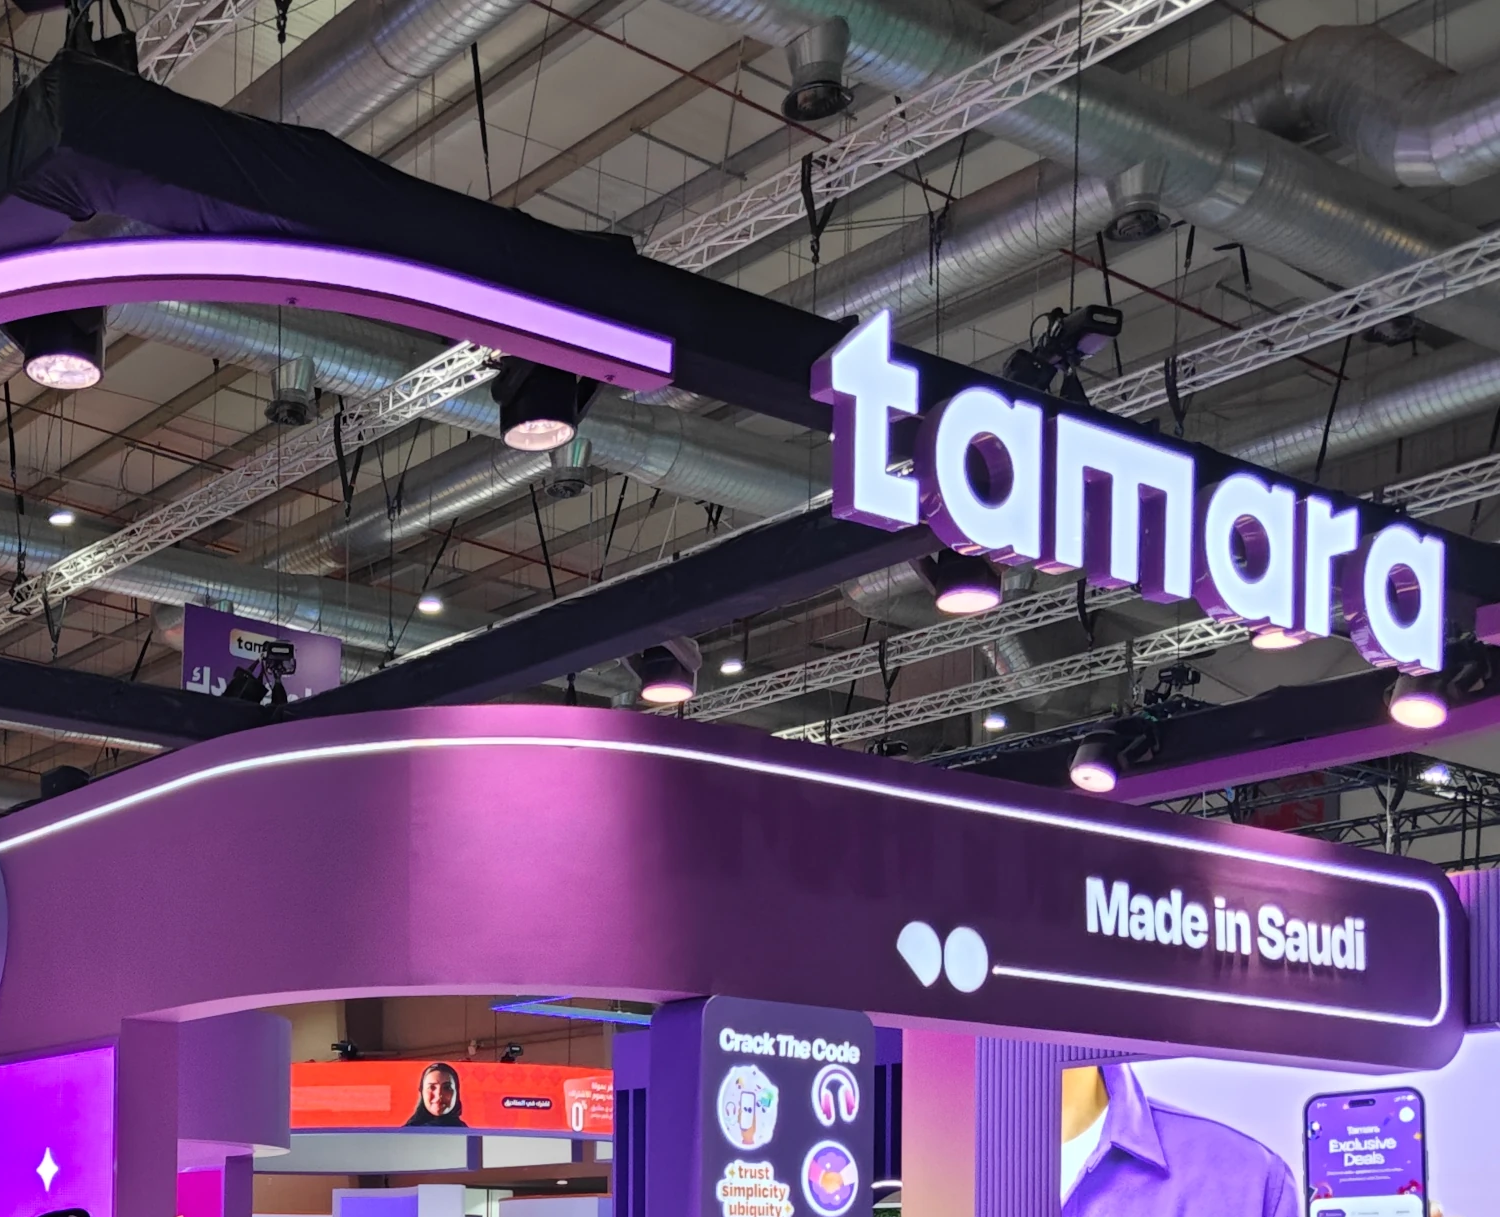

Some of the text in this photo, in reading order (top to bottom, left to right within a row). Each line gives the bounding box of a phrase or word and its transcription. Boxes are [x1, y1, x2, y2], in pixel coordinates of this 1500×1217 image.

[832, 309, 1446, 671] tamara
[237, 636, 268, 654] tam
[1086, 876, 1367, 972] Made in Saudi
[719, 1028, 861, 1064] Crack The Code
[1329, 1136, 1397, 1154] Exclusive
[1344, 1151, 1385, 1167] Deals
[738, 1165, 770, 1180] trust
[722, 1183, 786, 1200] simplicity
